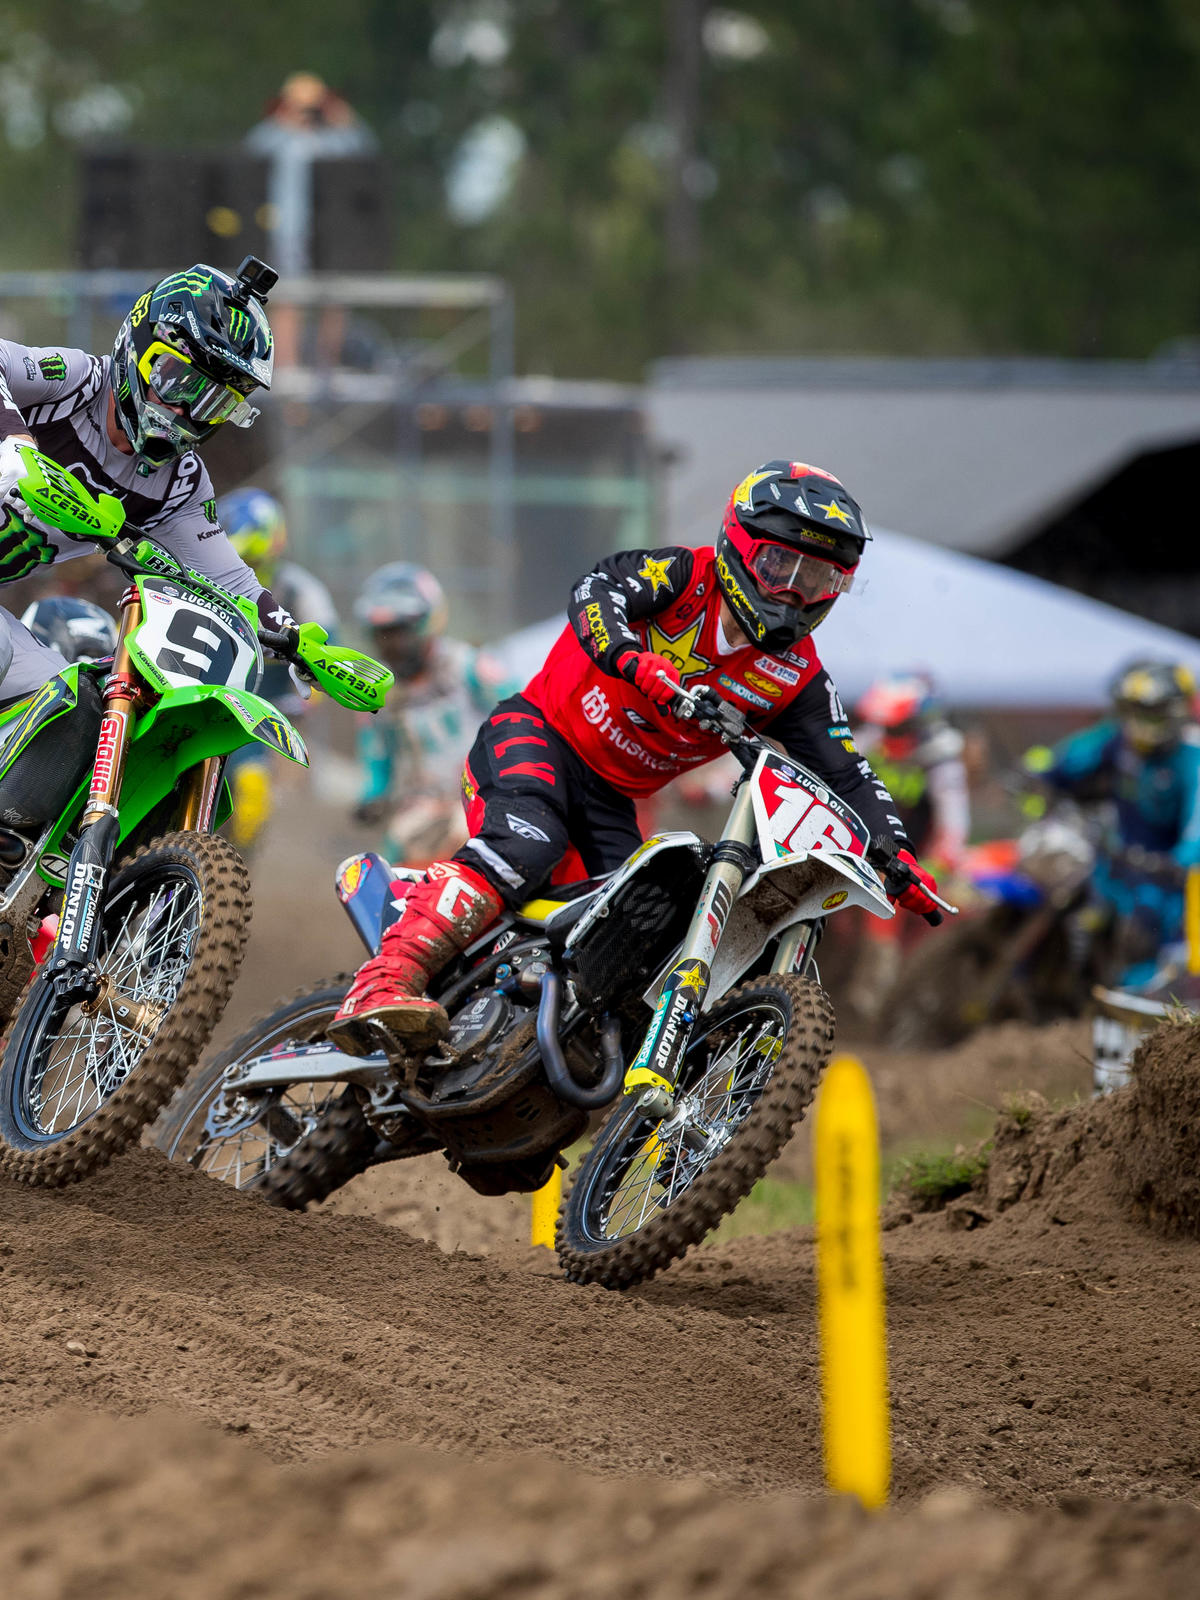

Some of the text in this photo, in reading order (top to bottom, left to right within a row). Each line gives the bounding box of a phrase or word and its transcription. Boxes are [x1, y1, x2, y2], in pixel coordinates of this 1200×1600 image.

[163, 312, 185, 324] FOX
[36, 487, 101, 529] ACERBIS
[180, 592, 219, 613] LUCAS
[219, 609, 233, 627] OIL
[136, 650, 168, 686] Kawasaki
[156, 608, 240, 686] 9
[313, 659, 377, 698] ACERBIS
[731, 682, 772, 710] MOTOREX
[90, 716, 119, 794] SHOWA
[768, 784, 853, 853] 16
[829, 800, 845, 817] OIL
[61, 862, 87, 950] DUNLOP
[80, 901, 97, 953] CARRILLO
[636, 1009, 664, 1067] MOTOREX
